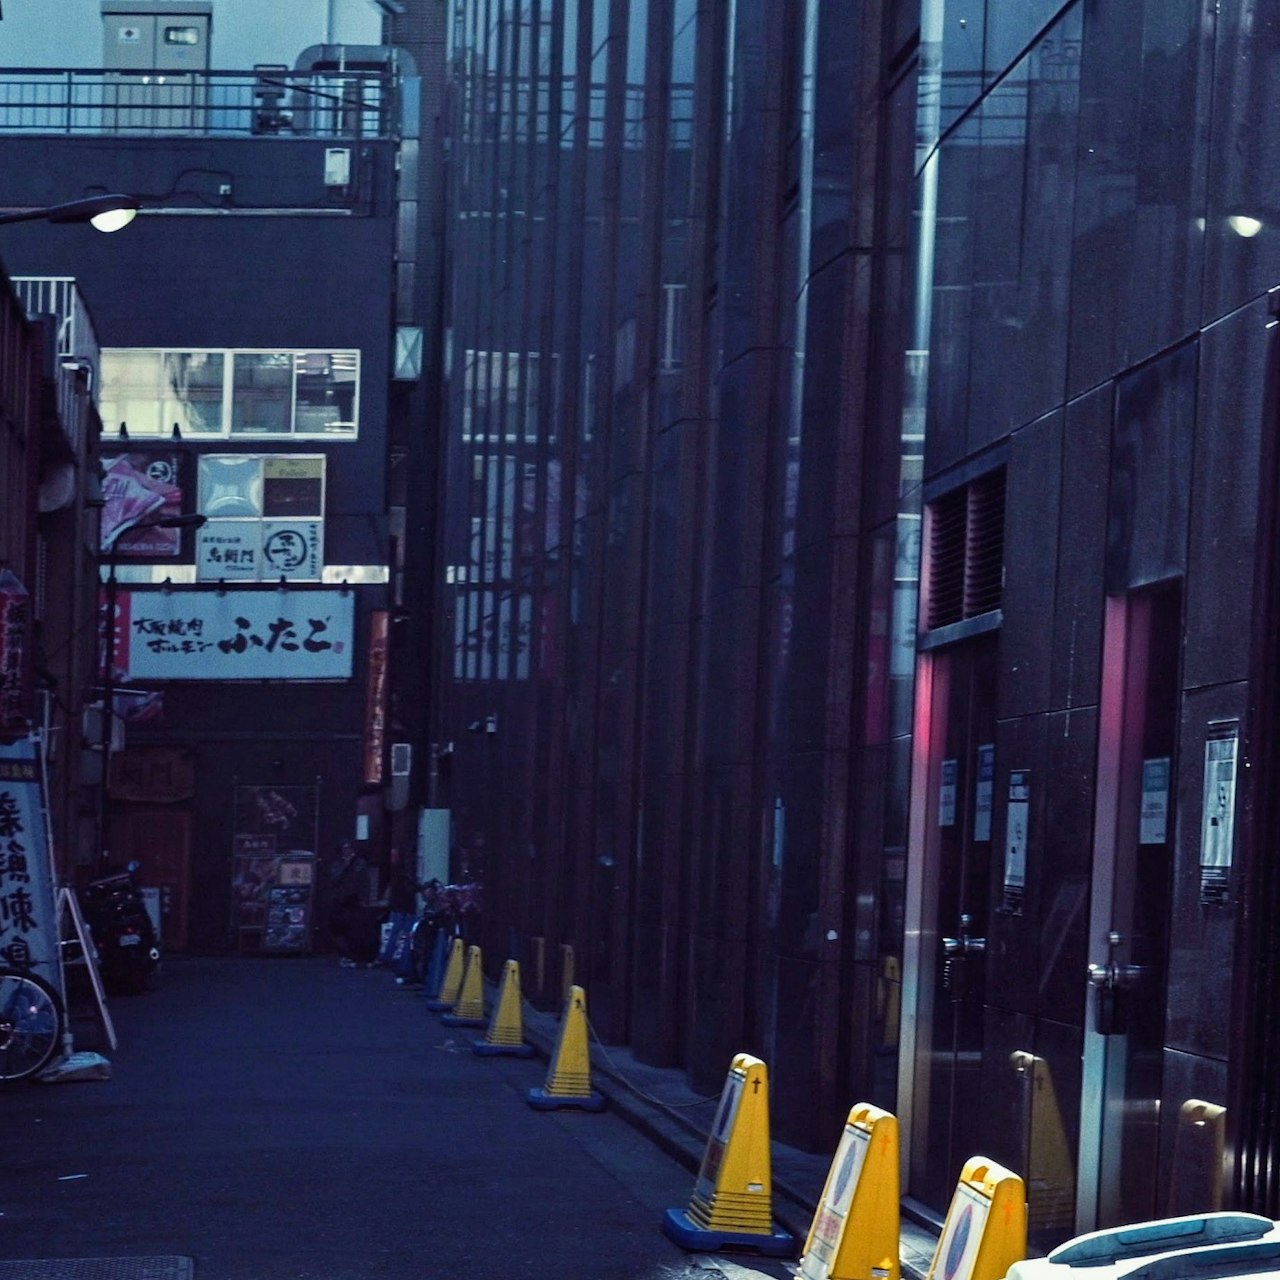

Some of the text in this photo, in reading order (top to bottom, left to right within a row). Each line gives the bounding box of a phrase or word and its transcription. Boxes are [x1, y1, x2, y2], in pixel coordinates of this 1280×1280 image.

[132, 617, 204, 637] 大阪焼肉
[217, 616, 332, 655] ふたご
[147, 638, 214, 654] ホルモン
